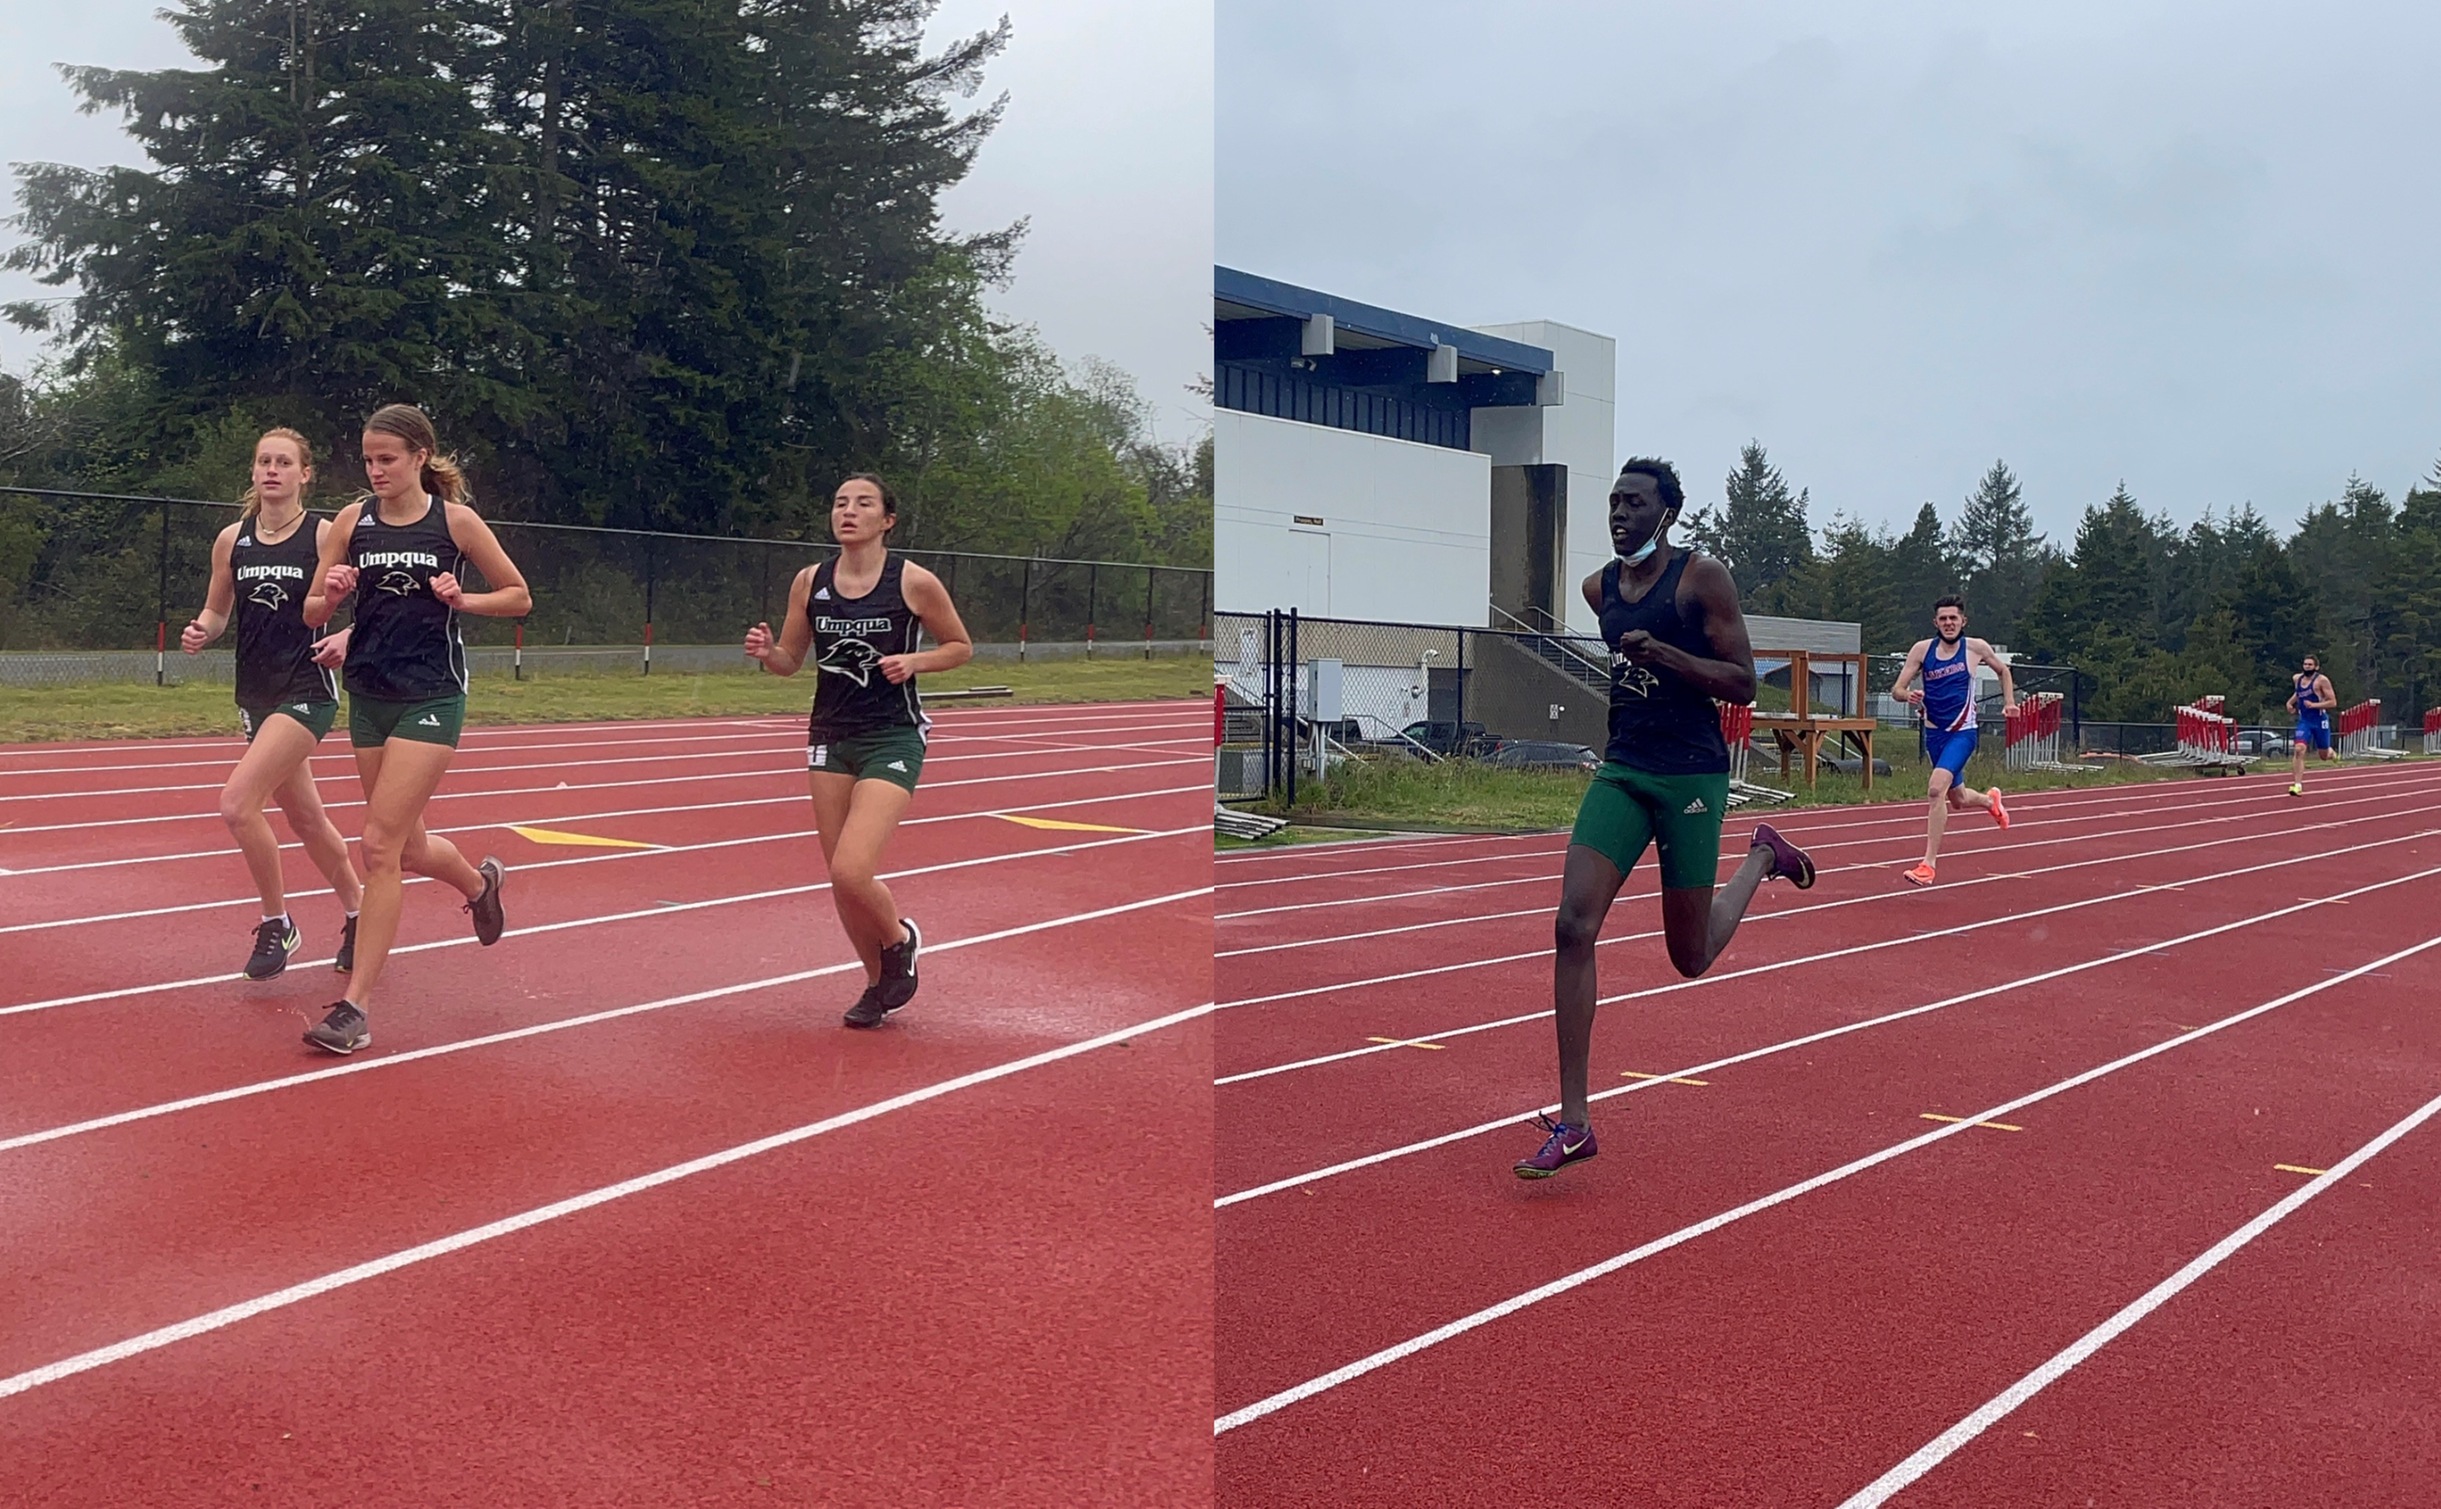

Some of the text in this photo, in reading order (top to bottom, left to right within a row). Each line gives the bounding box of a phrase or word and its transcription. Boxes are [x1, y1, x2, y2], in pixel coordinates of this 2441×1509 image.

[359, 551, 439, 569] Umpqua
[237, 564, 304, 581] Umpqua
[815, 616, 892, 637] Umpqua
